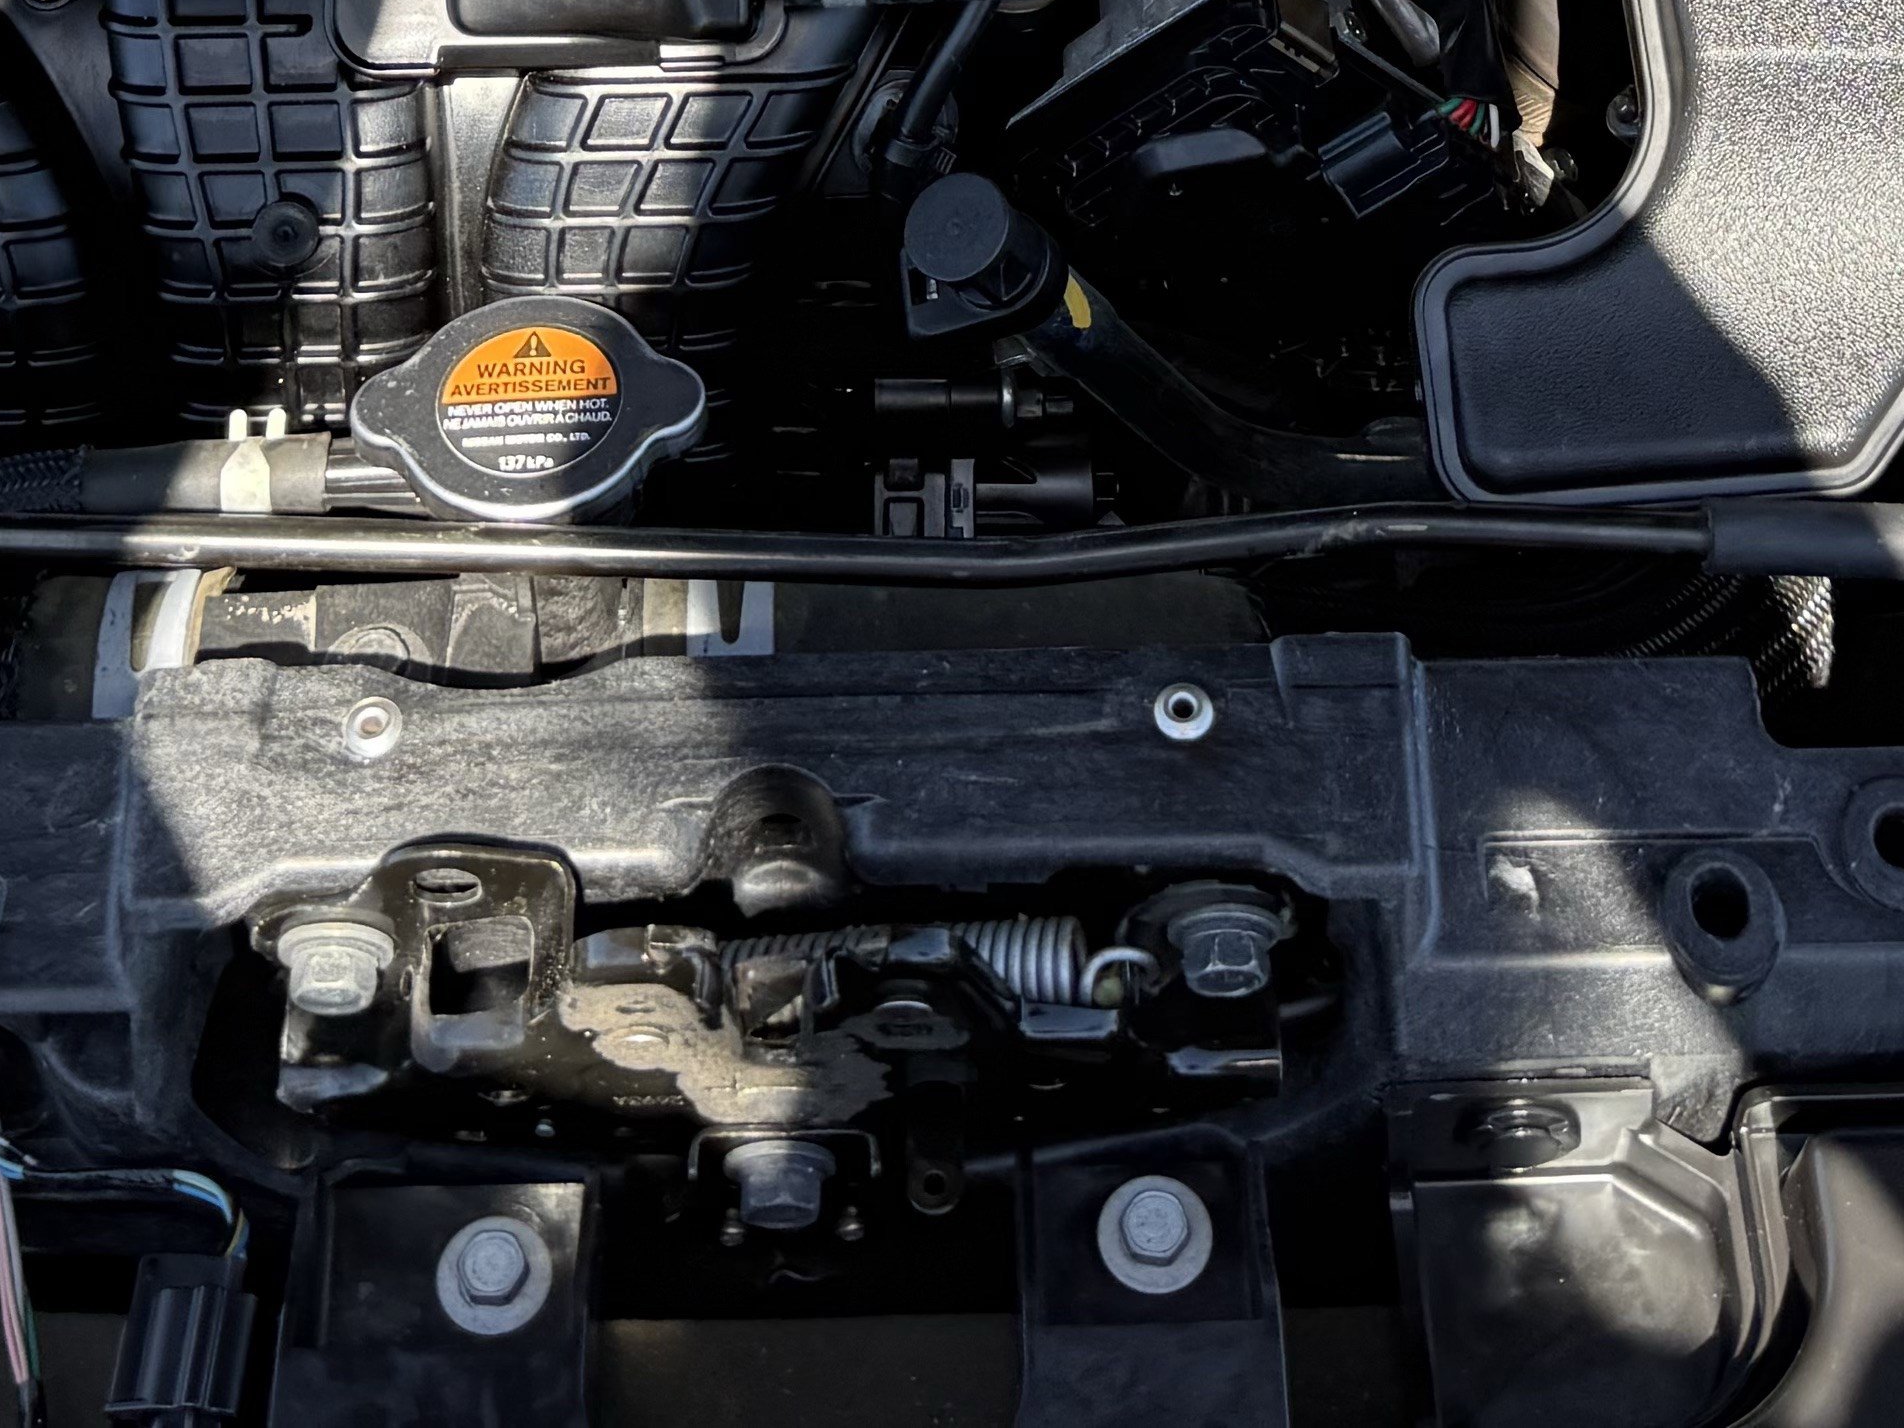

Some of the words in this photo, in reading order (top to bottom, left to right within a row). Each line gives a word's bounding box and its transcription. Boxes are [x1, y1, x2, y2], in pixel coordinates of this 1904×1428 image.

[477, 358, 586, 379] WARNING
[450, 376, 611, 398] AVERTISSEMENT
[447, 402, 493, 418] NEVER
[493, 400, 534, 415] OPEN
[534, 398, 577, 412] WHEN
[579, 398, 609, 410] HOT.
[443, 418, 462, 431] NE
[461, 414, 506, 430] JAMAIS
[565, 411, 612, 424] CHAUD.
